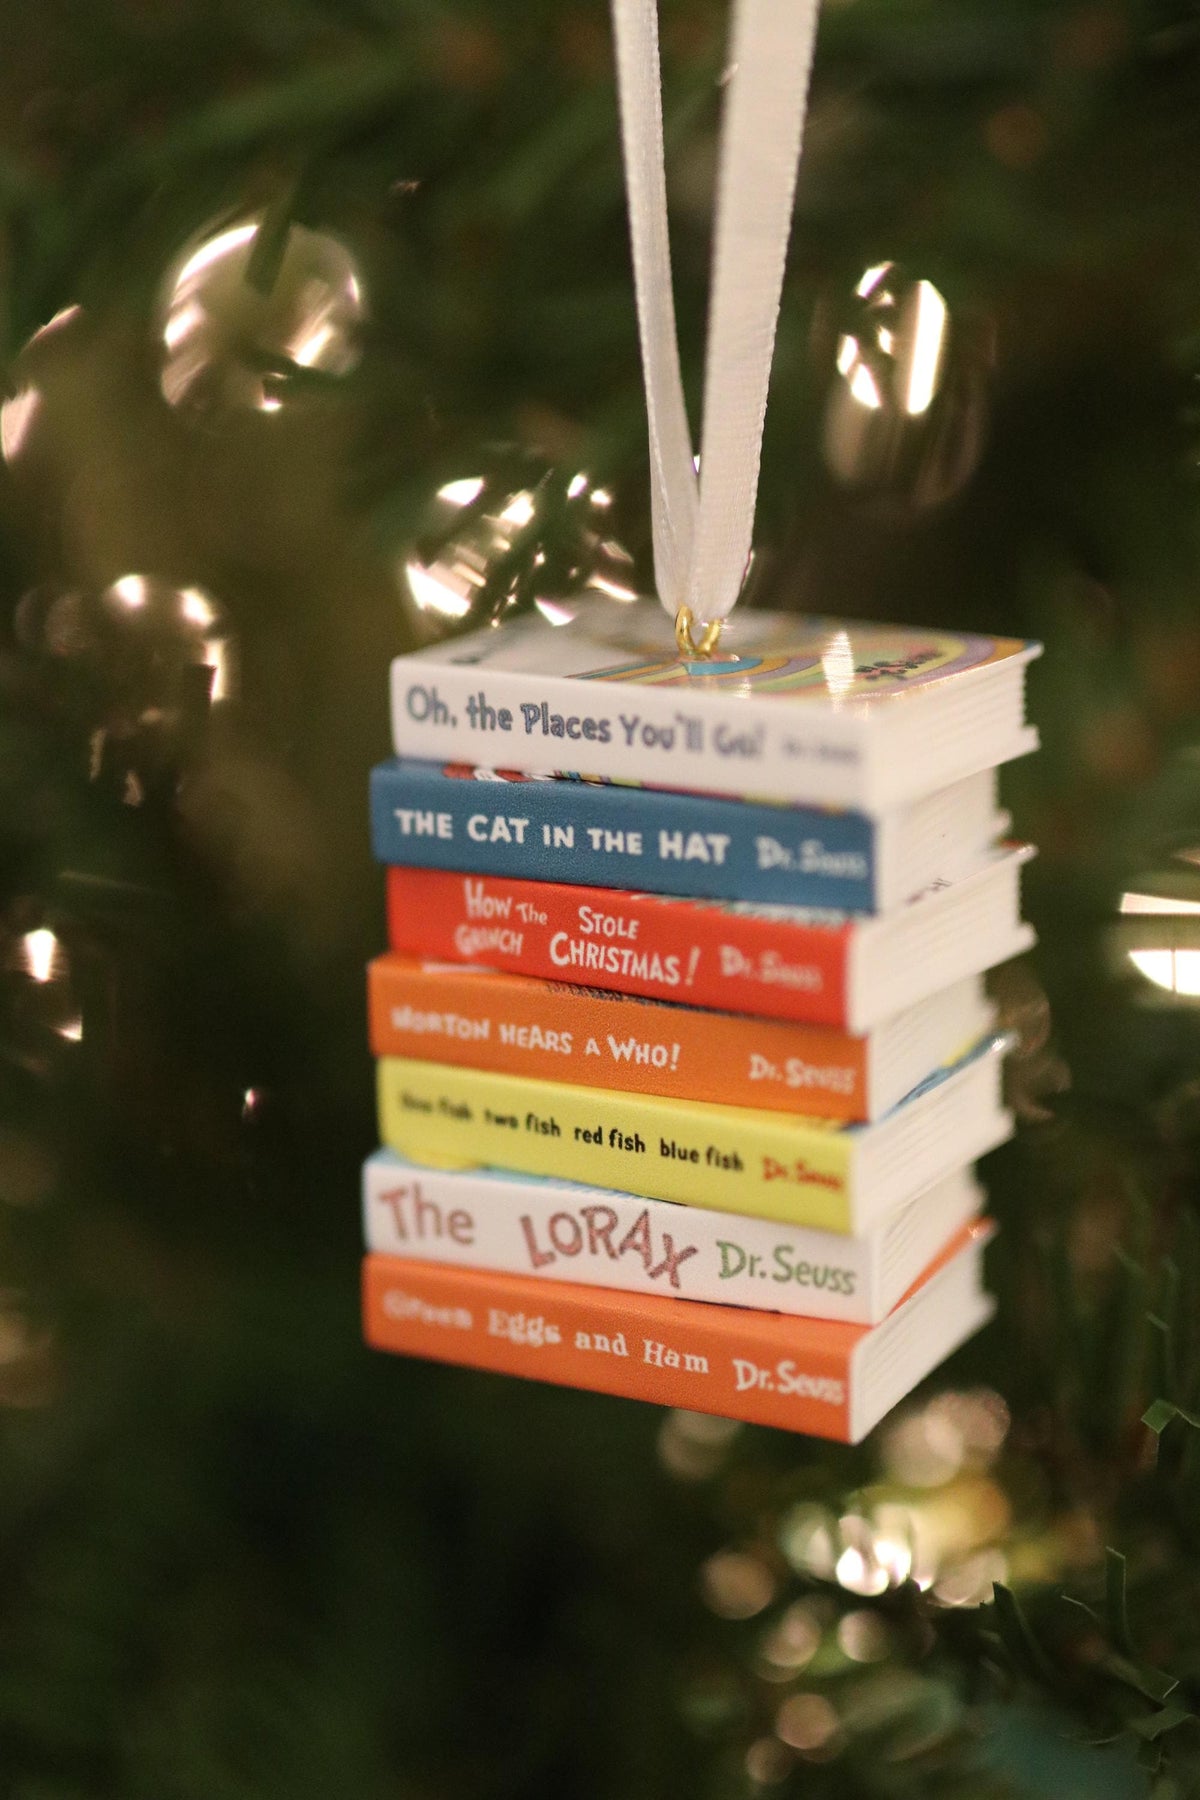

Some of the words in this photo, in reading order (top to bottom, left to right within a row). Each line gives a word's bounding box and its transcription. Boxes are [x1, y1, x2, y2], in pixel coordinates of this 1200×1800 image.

[465, 691, 513, 731] the
[520, 701, 612, 743] Places
[395, 809, 453, 839] THE
[467, 814, 530, 844] CAT
[542, 824, 574, 848] IN
[586, 827, 642, 856] THE
[658, 829, 731, 865] HAT
[515, 902, 548, 926] The
[578, 905, 640, 940] STOLE
[499, 1025, 573, 1055] HEARS
[585, 1038, 601, 1057] A
[606, 1035, 681, 1071] WHO!
[525, 1113, 561, 1137] fish
[574, 1126, 603, 1145] red
[609, 1128, 646, 1153] fish
[660, 1137, 699, 1164] blue
[706, 1145, 744, 1172] fish
[378, 1182, 475, 1245] The
[519, 1204, 698, 1289] LORAX
[772, 1244, 857, 1295] Seuss
[487, 1307, 561, 1347] Eggs
[574, 1331, 629, 1357] and
[643, 1338, 709, 1374] Ham
